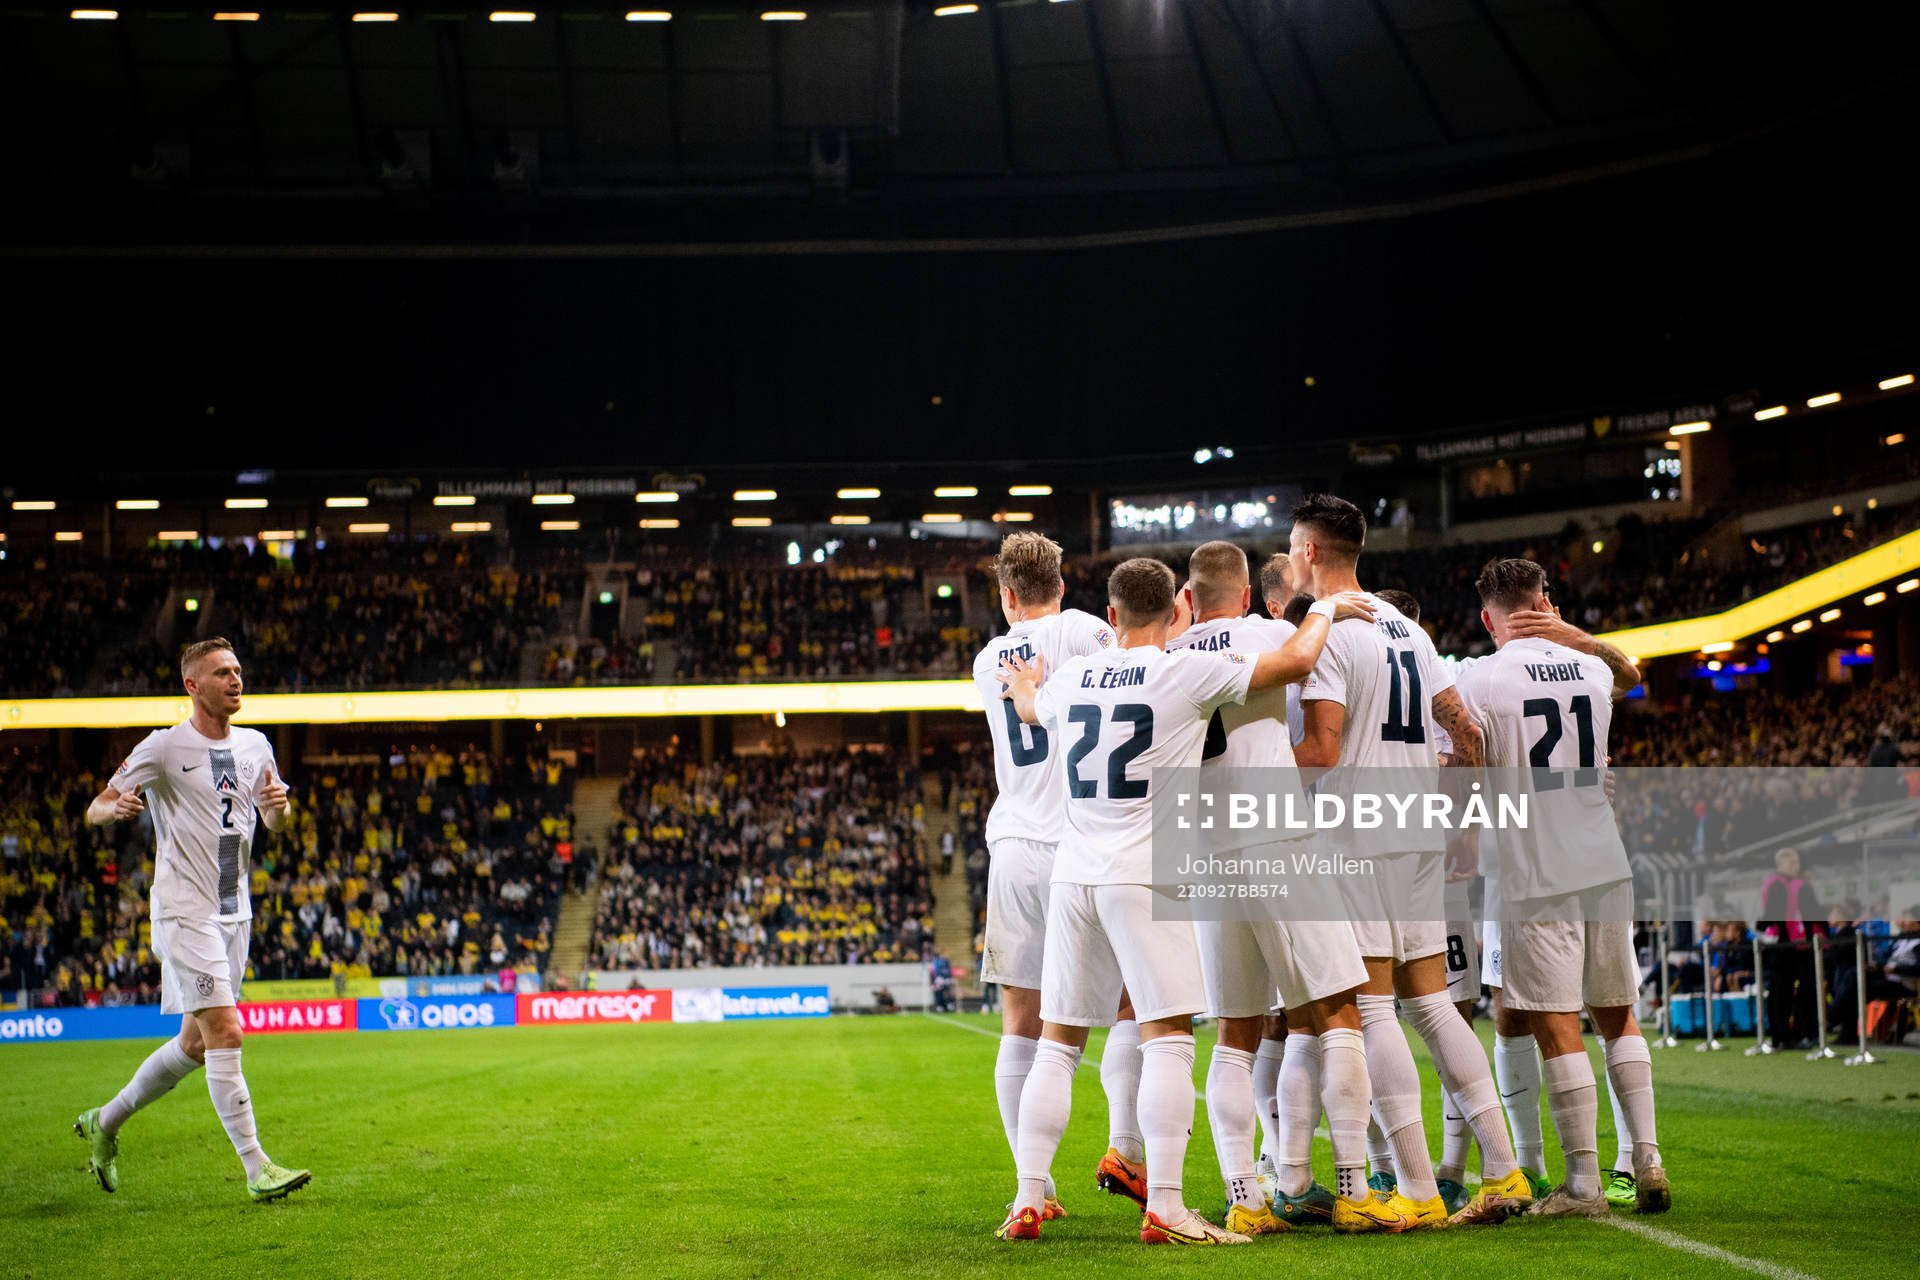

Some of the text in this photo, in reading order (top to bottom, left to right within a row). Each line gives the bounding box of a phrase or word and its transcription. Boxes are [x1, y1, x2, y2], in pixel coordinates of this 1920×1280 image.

[1099, 666, 1147, 689] ČERIN
[1524, 659, 1585, 682] VERBIČ
[1381, 646, 1426, 744] 11
[1066, 703, 1155, 799] 22
[1523, 695, 1599, 793] 21
[221, 797, 234, 828] 2
[0, 1014, 63, 1039] onto
[421, 1002, 495, 1028] OBOS
